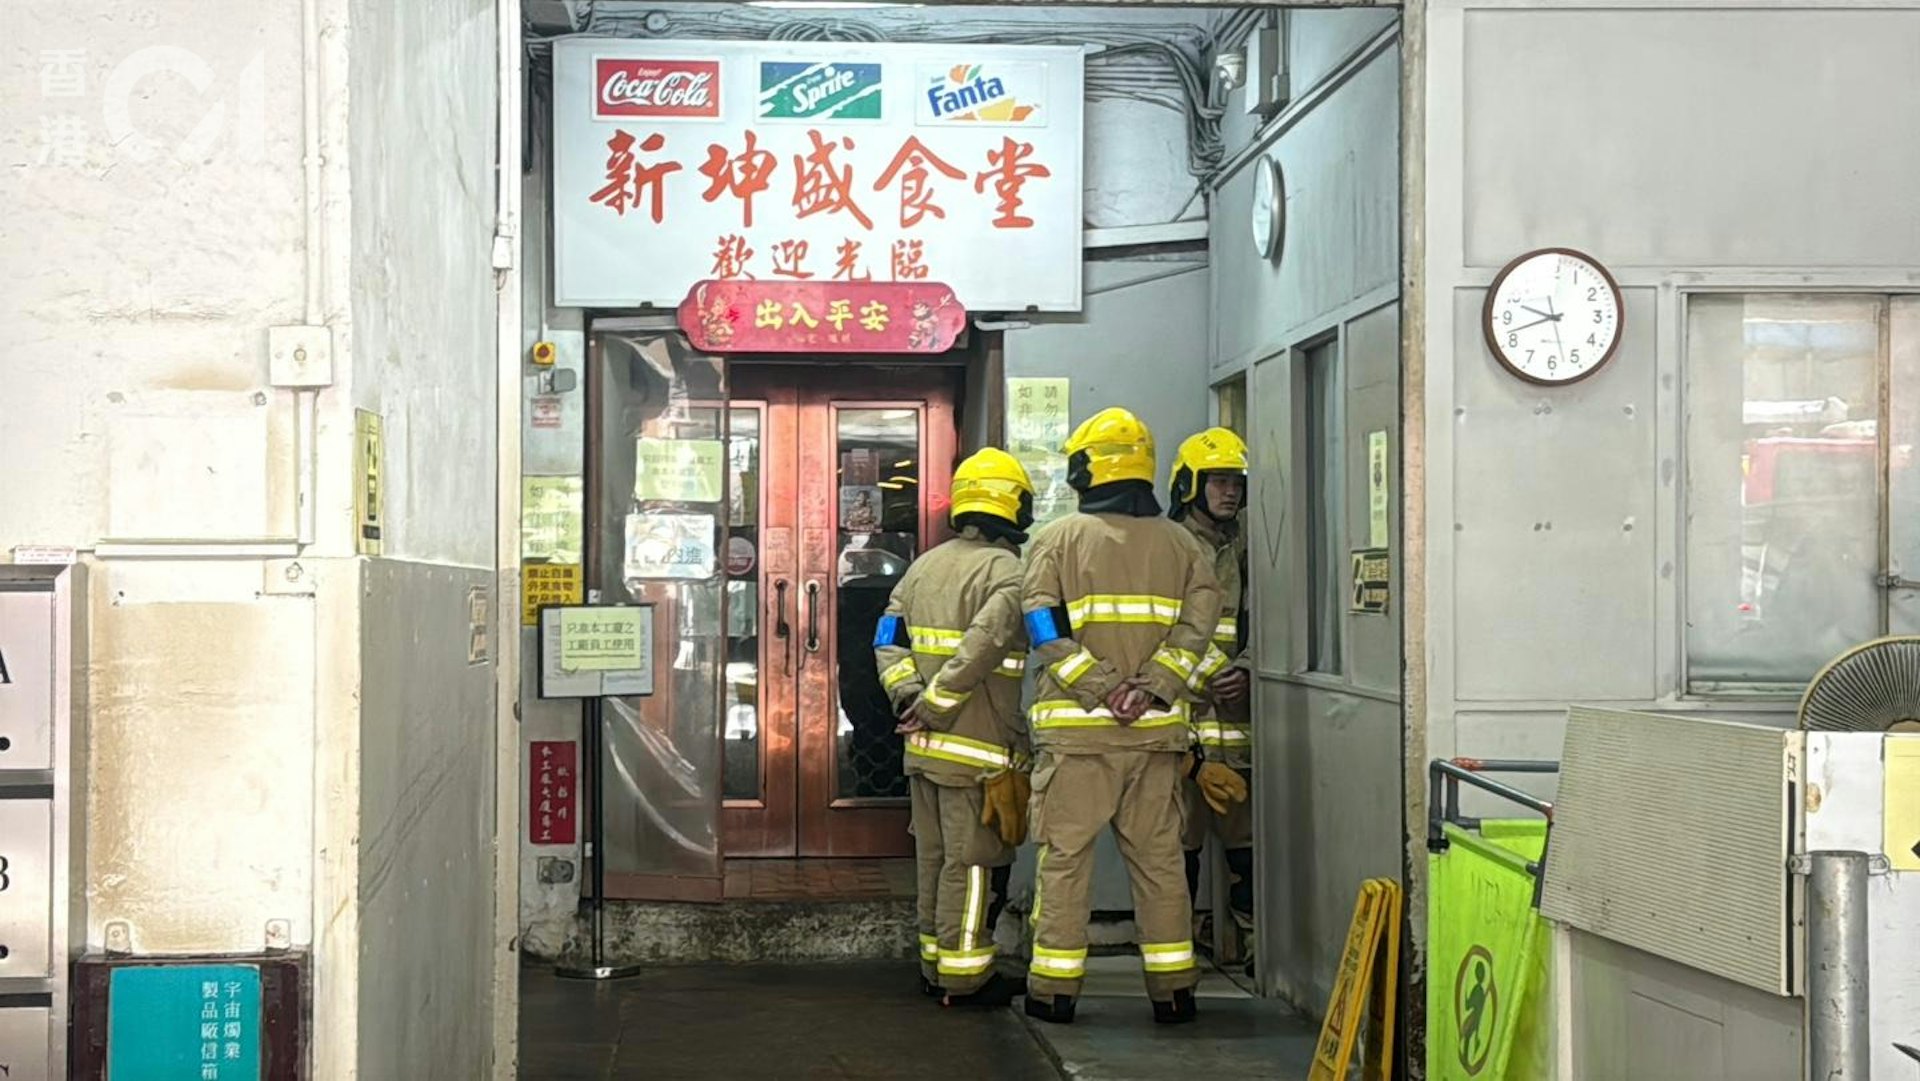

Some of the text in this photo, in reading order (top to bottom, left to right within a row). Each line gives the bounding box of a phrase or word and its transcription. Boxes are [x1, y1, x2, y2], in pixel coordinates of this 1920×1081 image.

[602, 70, 713, 107] Coca-Cola
[792, 66, 855, 113] Sprite
[927, 76, 1005, 117] Fanta
[589, 128, 1051, 230] 新坤盛食堂
[709, 235, 929, 282] 歡迎光臨
[1587, 287, 1597, 301] 2
[755, 298, 891, 332] 出入平安
[1502, 310, 1512, 325] 9
[1593, 310, 1602, 323] 3
[1508, 333, 1518, 348] 8
[1586, 333, 1596, 346] 4
[1525, 349, 1535, 363] 7
[1547, 355, 1557, 370] 6
[1570, 349, 1580, 363] 5
[201, 980, 219, 1080] 製品廠信箱
